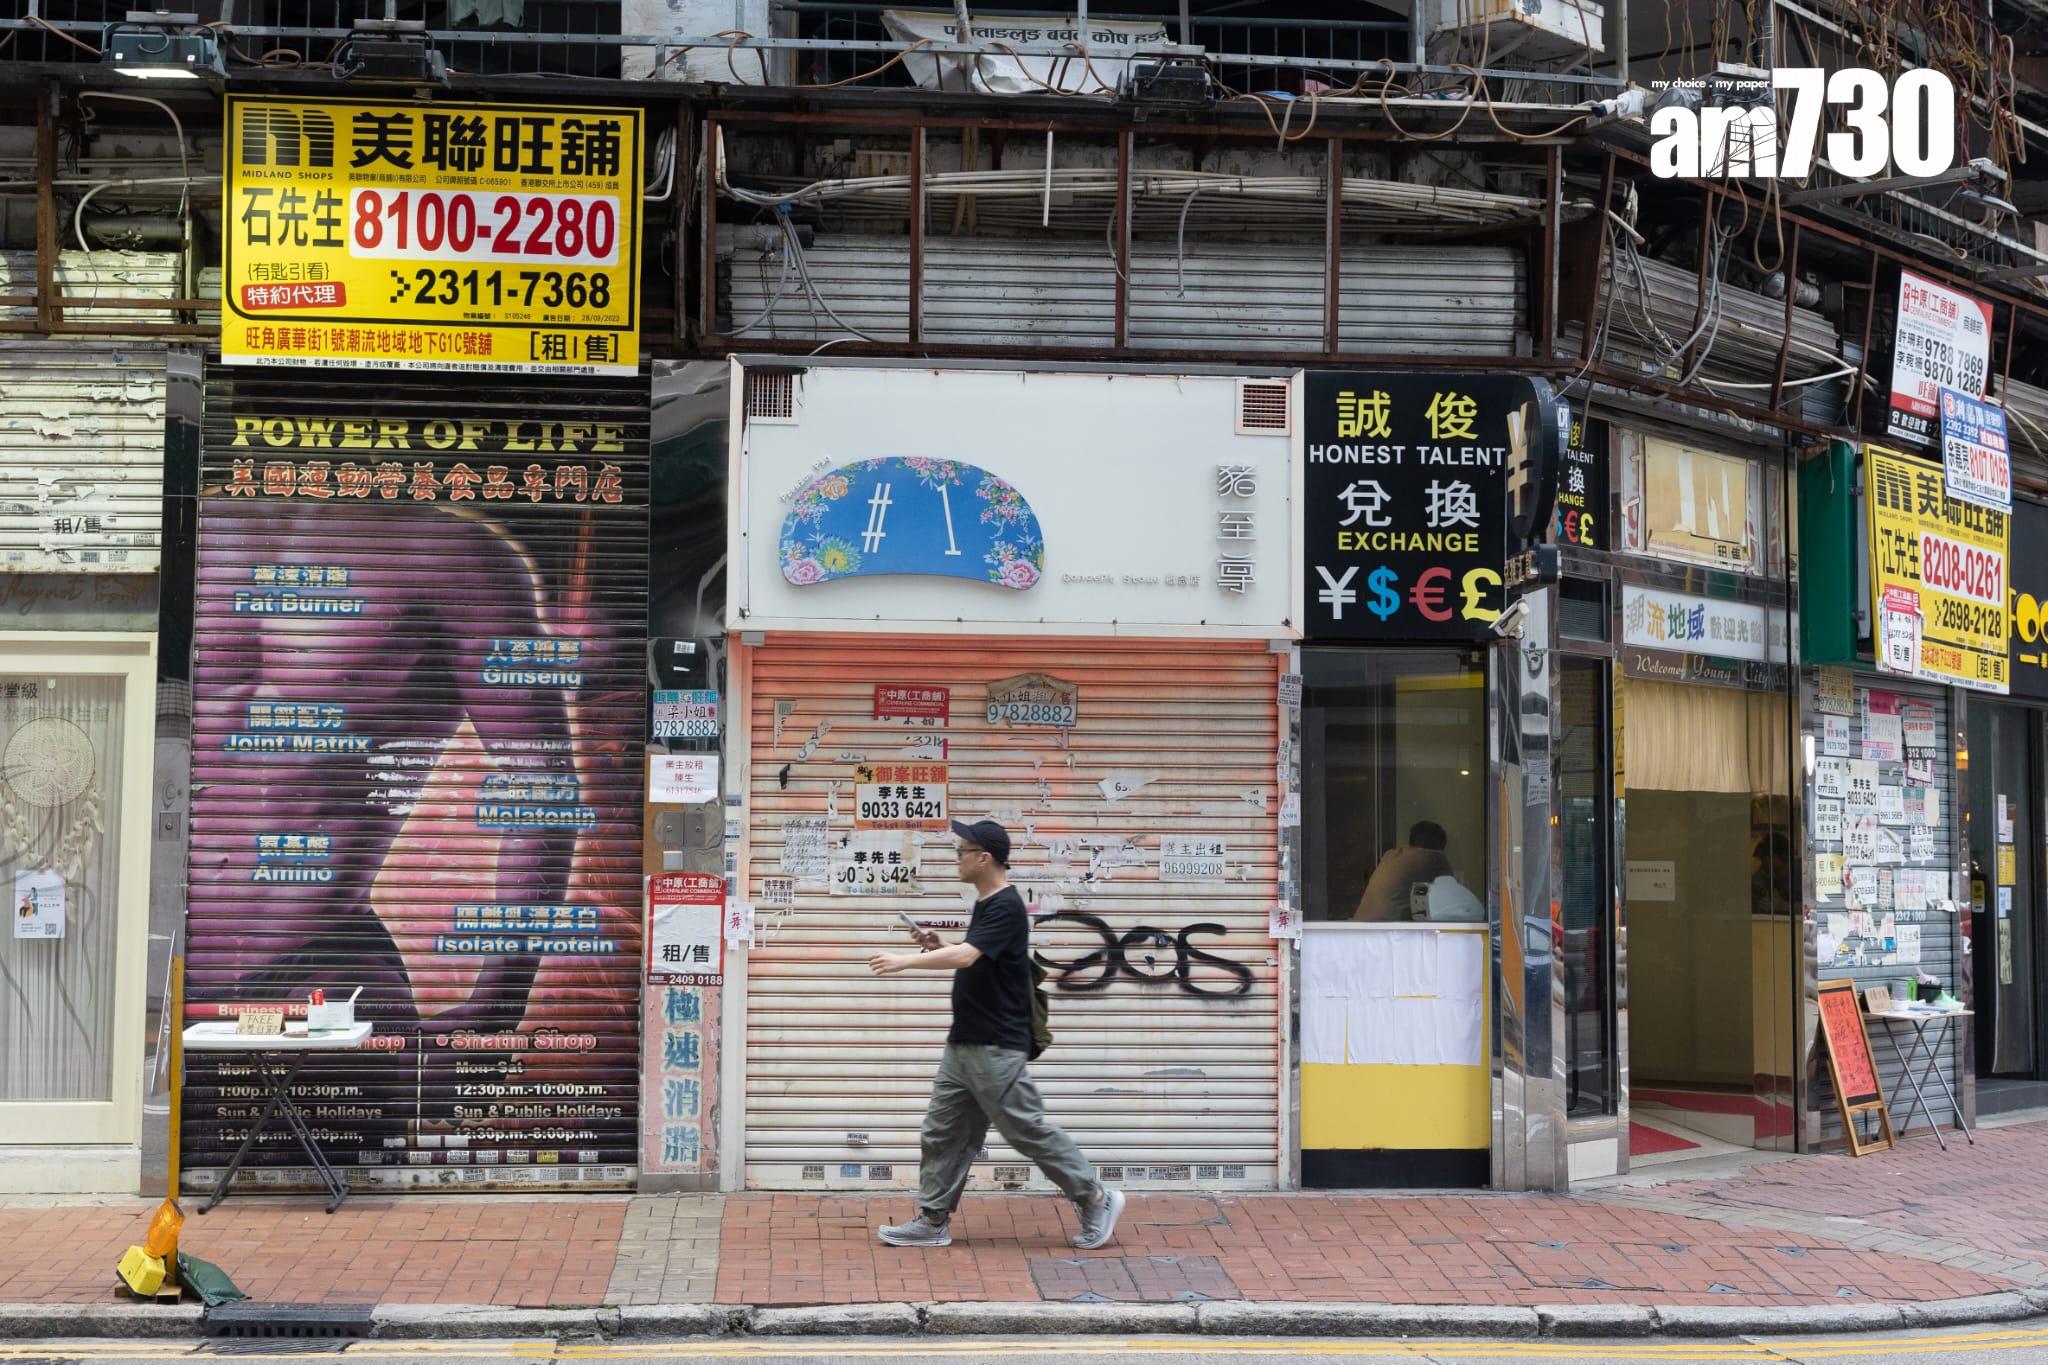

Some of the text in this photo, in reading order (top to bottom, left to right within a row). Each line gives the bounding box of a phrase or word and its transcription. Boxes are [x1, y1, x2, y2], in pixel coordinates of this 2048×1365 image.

[348, 111, 620, 177] 美聯旺舖
[242, 170, 334, 181] MIDLAND SHOPS
[241, 187, 615, 259] 石先生 8100-2280
[247, 287, 338, 306] 特約代理
[414, 269, 610, 309] 2311-7368
[1924, 359, 1953, 386] 9870
[1957, 370, 1983, 397] 1286
[231, 416, 626, 453] POWER OF LIFE
[1309, 444, 1506, 466] HONEST TALENT
[1216, 463, 1258, 595] 豬至尊
[1338, 532, 1480, 552] EXCHANGE
[1923, 536, 2002, 603] 8208-0261
[234, 592, 365, 614] Fat Burner
[1625, 593, 1706, 642] 潮流地域
[1942, 598, 2002, 640] 2698-2128
[1635, 653, 1681, 676] Welcome
[1692, 655, 1732, 682] Young
[482, 668, 582, 690] Ginseng
[988, 703, 1073, 723] 97828882
[878, 785, 926, 800] 李先生
[861, 801, 942, 819] 9033 6421
[854, 850, 902, 865] 李先生
[1163, 861, 1224, 876] 96999208
[526, 936, 614, 954] Protein
[662, 944, 711, 963] 租/售
[669, 974, 695, 985] 2409
[697, 975, 723, 985] 0188
[450, 1030, 530, 1051] Shatin
[533, 1030, 597, 1055] Shop
[315, 1106, 383, 1120] Holidays
[453, 1104, 483, 1119] Sun
[504, 1104, 551, 1119] Public
[557, 1104, 622, 1121] Holidays
